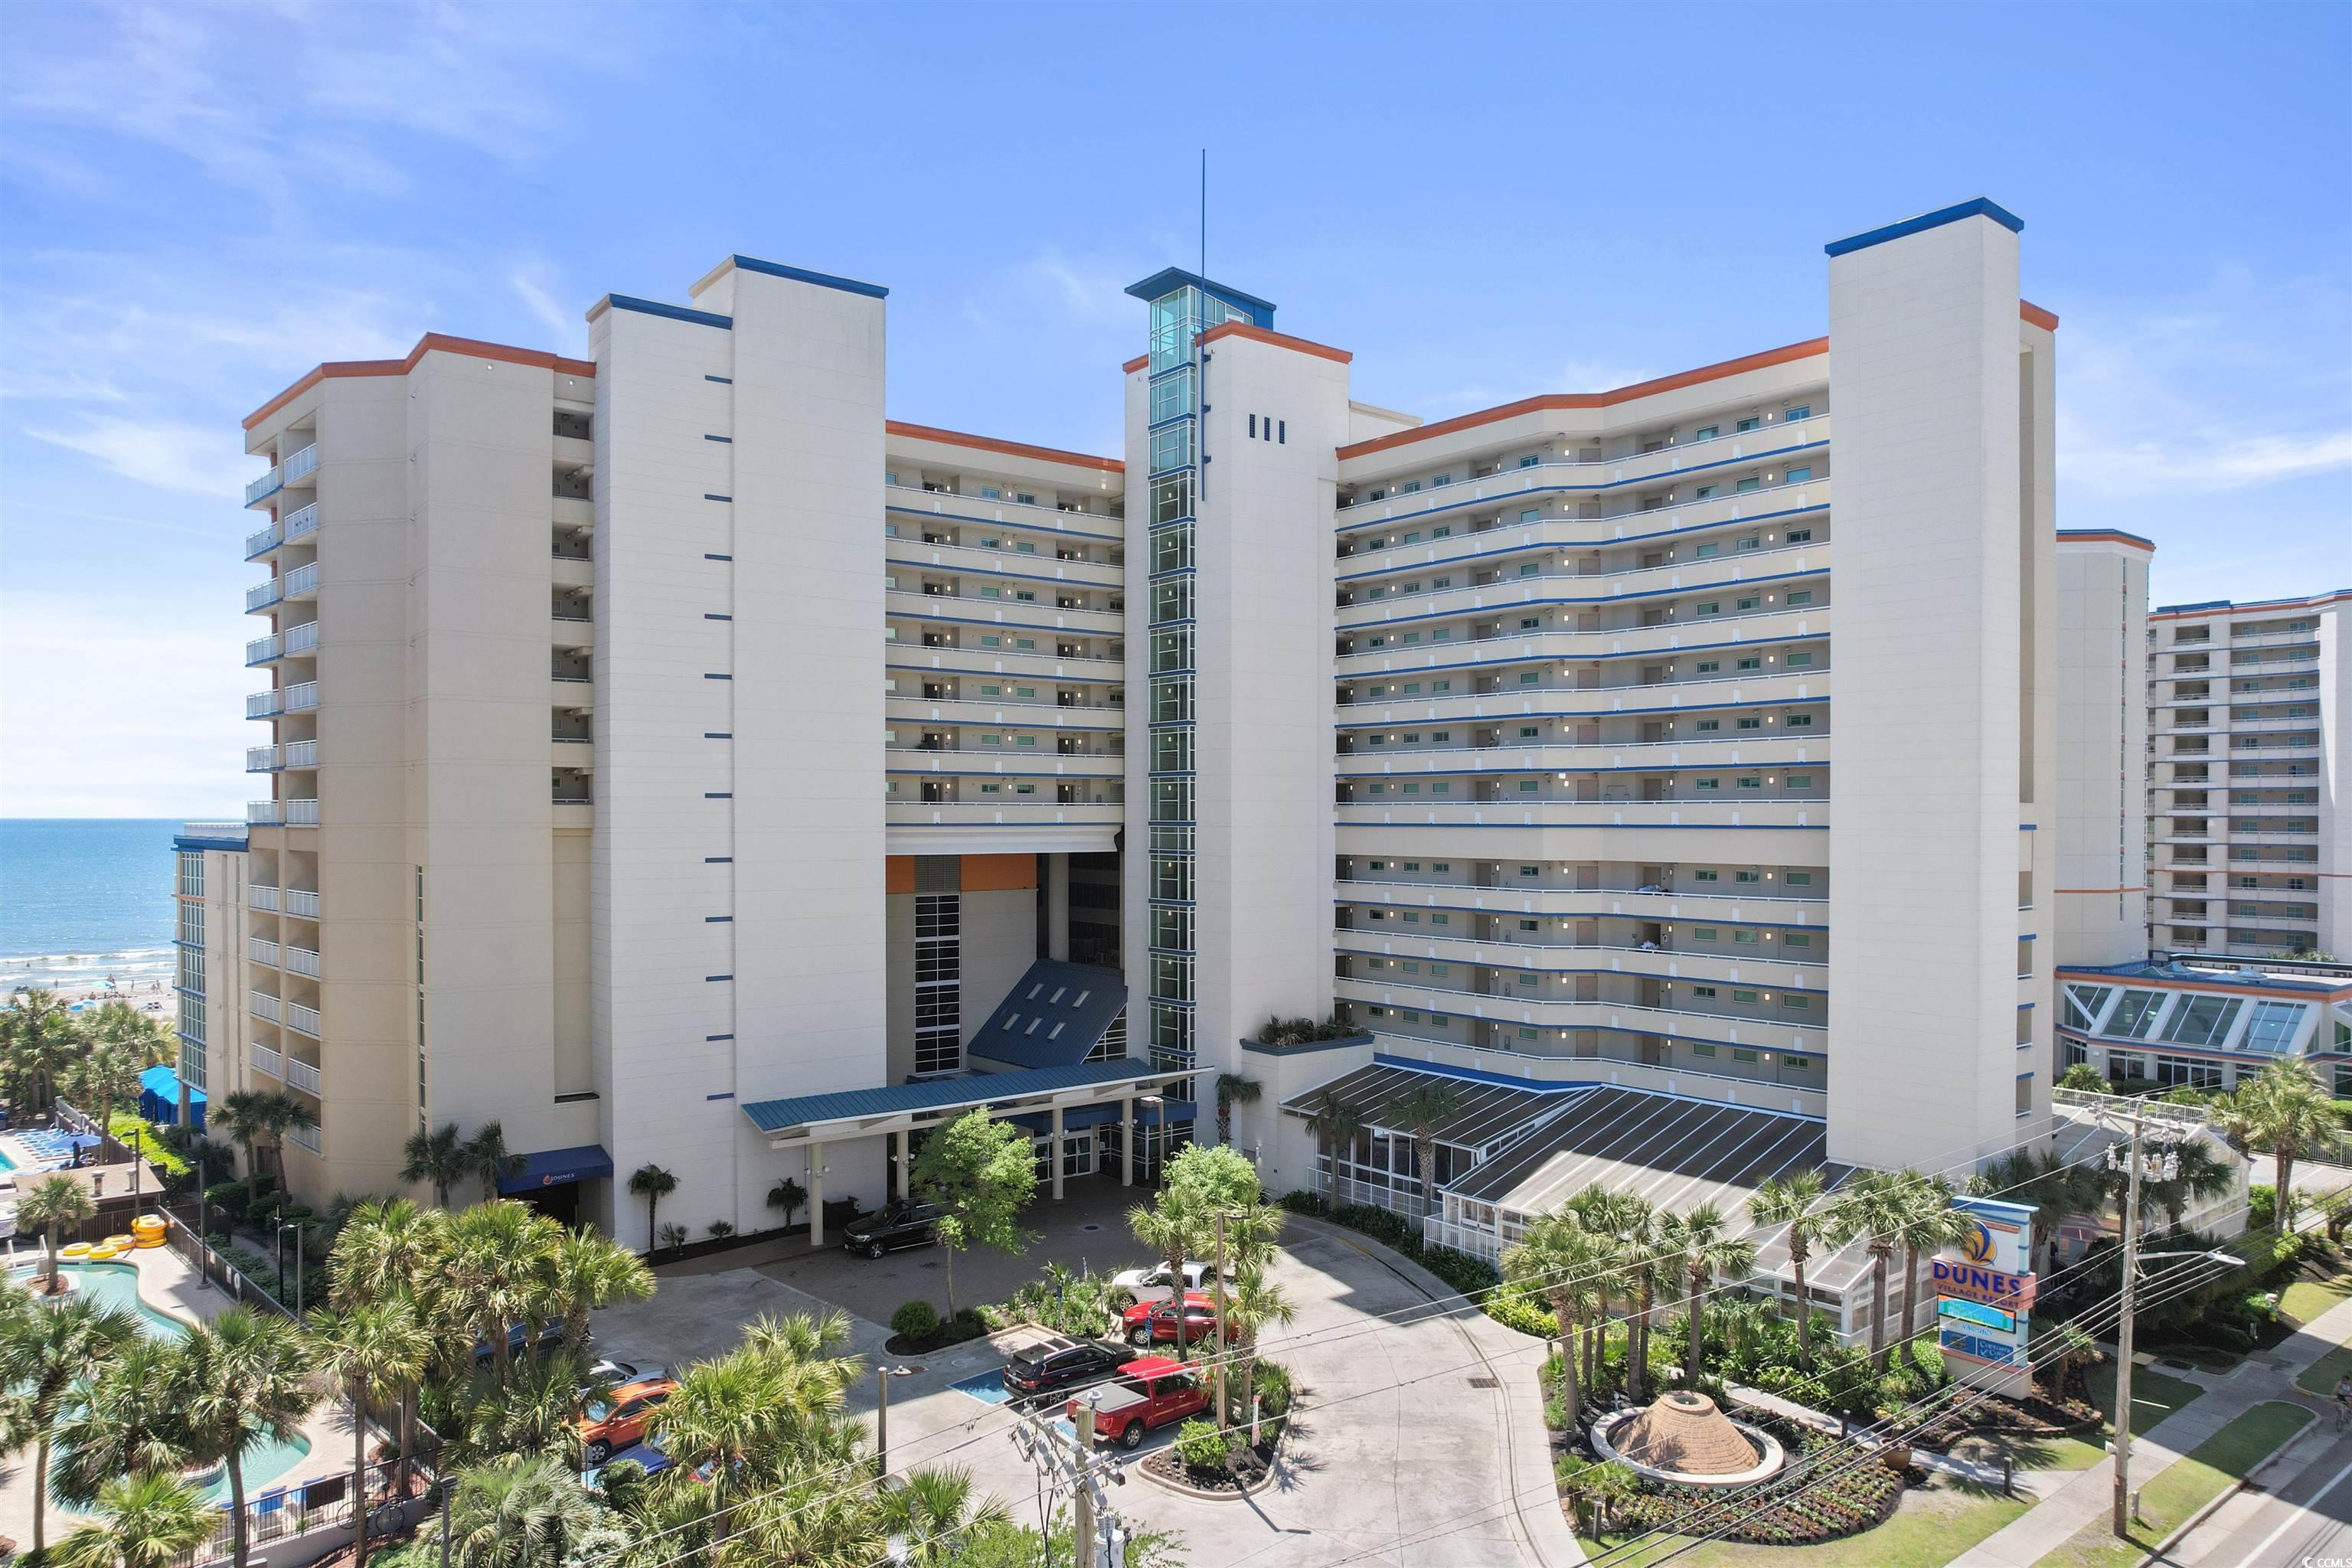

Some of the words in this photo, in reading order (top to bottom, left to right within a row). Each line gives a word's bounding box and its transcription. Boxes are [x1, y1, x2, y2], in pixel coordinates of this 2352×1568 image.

[1933, 1261, 2021, 1297] DUNES
[1937, 1283, 1978, 1298] VILLAGE
[1982, 1295, 2019, 1308] RESORT
